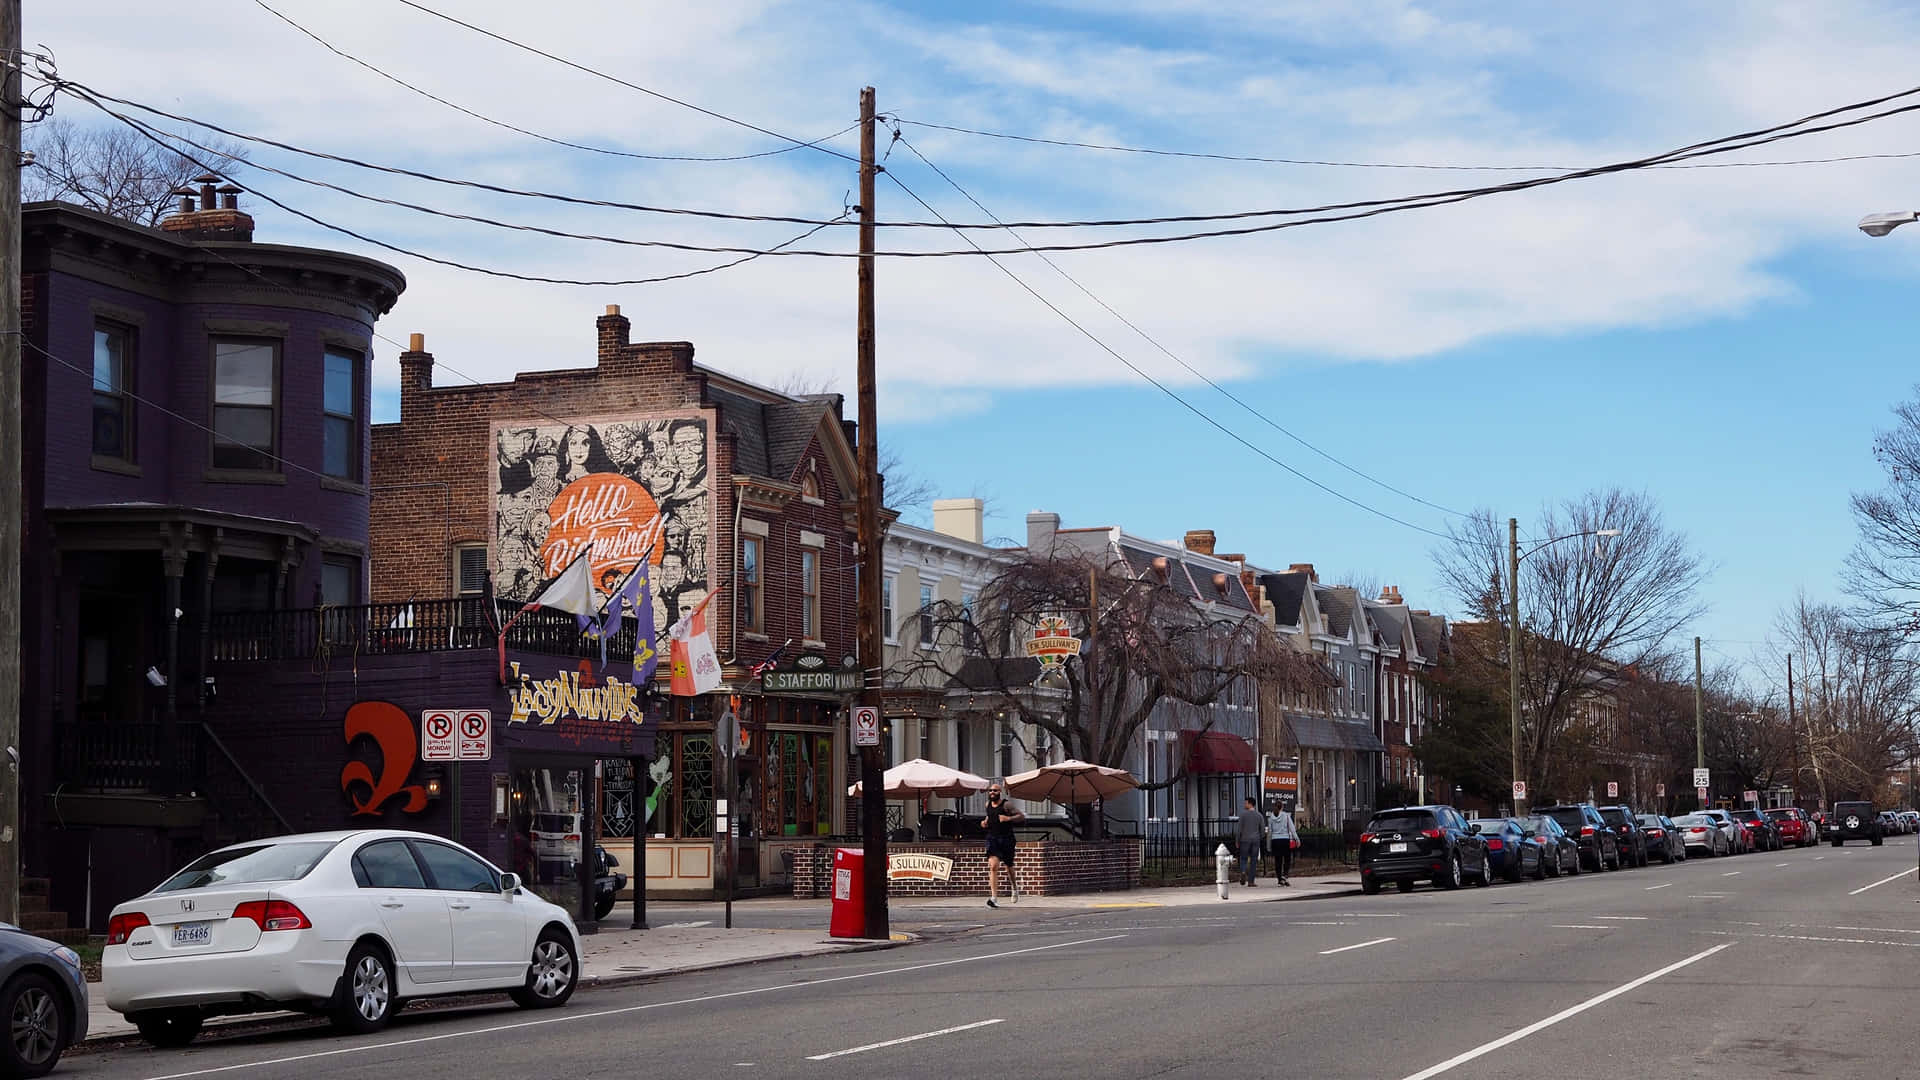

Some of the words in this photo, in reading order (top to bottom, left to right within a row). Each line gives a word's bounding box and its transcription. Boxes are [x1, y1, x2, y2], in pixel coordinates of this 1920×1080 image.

[551, 484, 633, 531] Hello
[1041, 640, 1076, 649] SULLIVAN'S
[765, 674, 774, 688] S
[780, 673, 834, 688] STAFFOR
[1265, 776, 1277, 784] FOR
[1279, 777, 1296, 785] LEASE
[1696, 777, 1708, 785] 25
[896, 858, 945, 872] SULLIVAN'S
